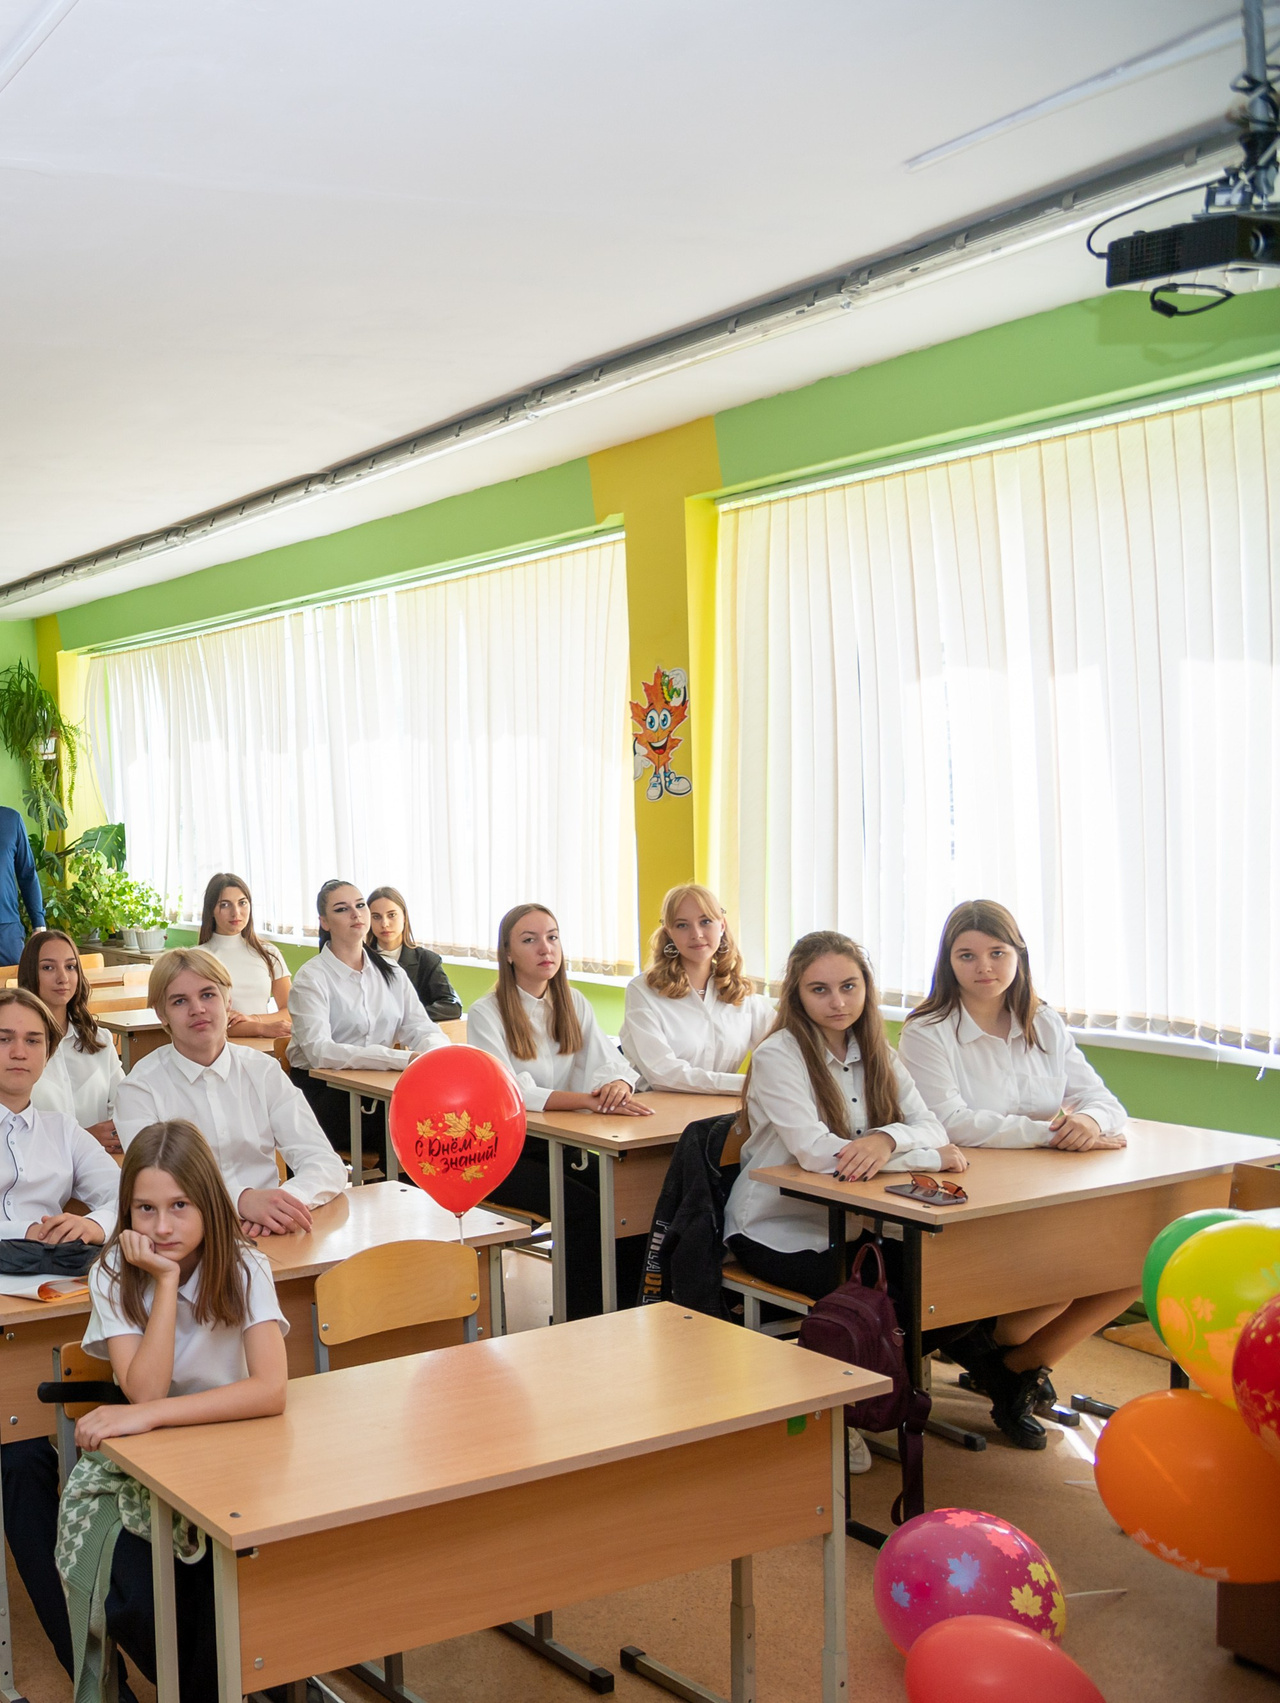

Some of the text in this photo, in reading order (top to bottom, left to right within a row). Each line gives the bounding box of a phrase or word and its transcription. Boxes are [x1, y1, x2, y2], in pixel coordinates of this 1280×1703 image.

[415, 1137, 473, 1157] С Днём
[440, 1137, 499, 1174] знаний!
